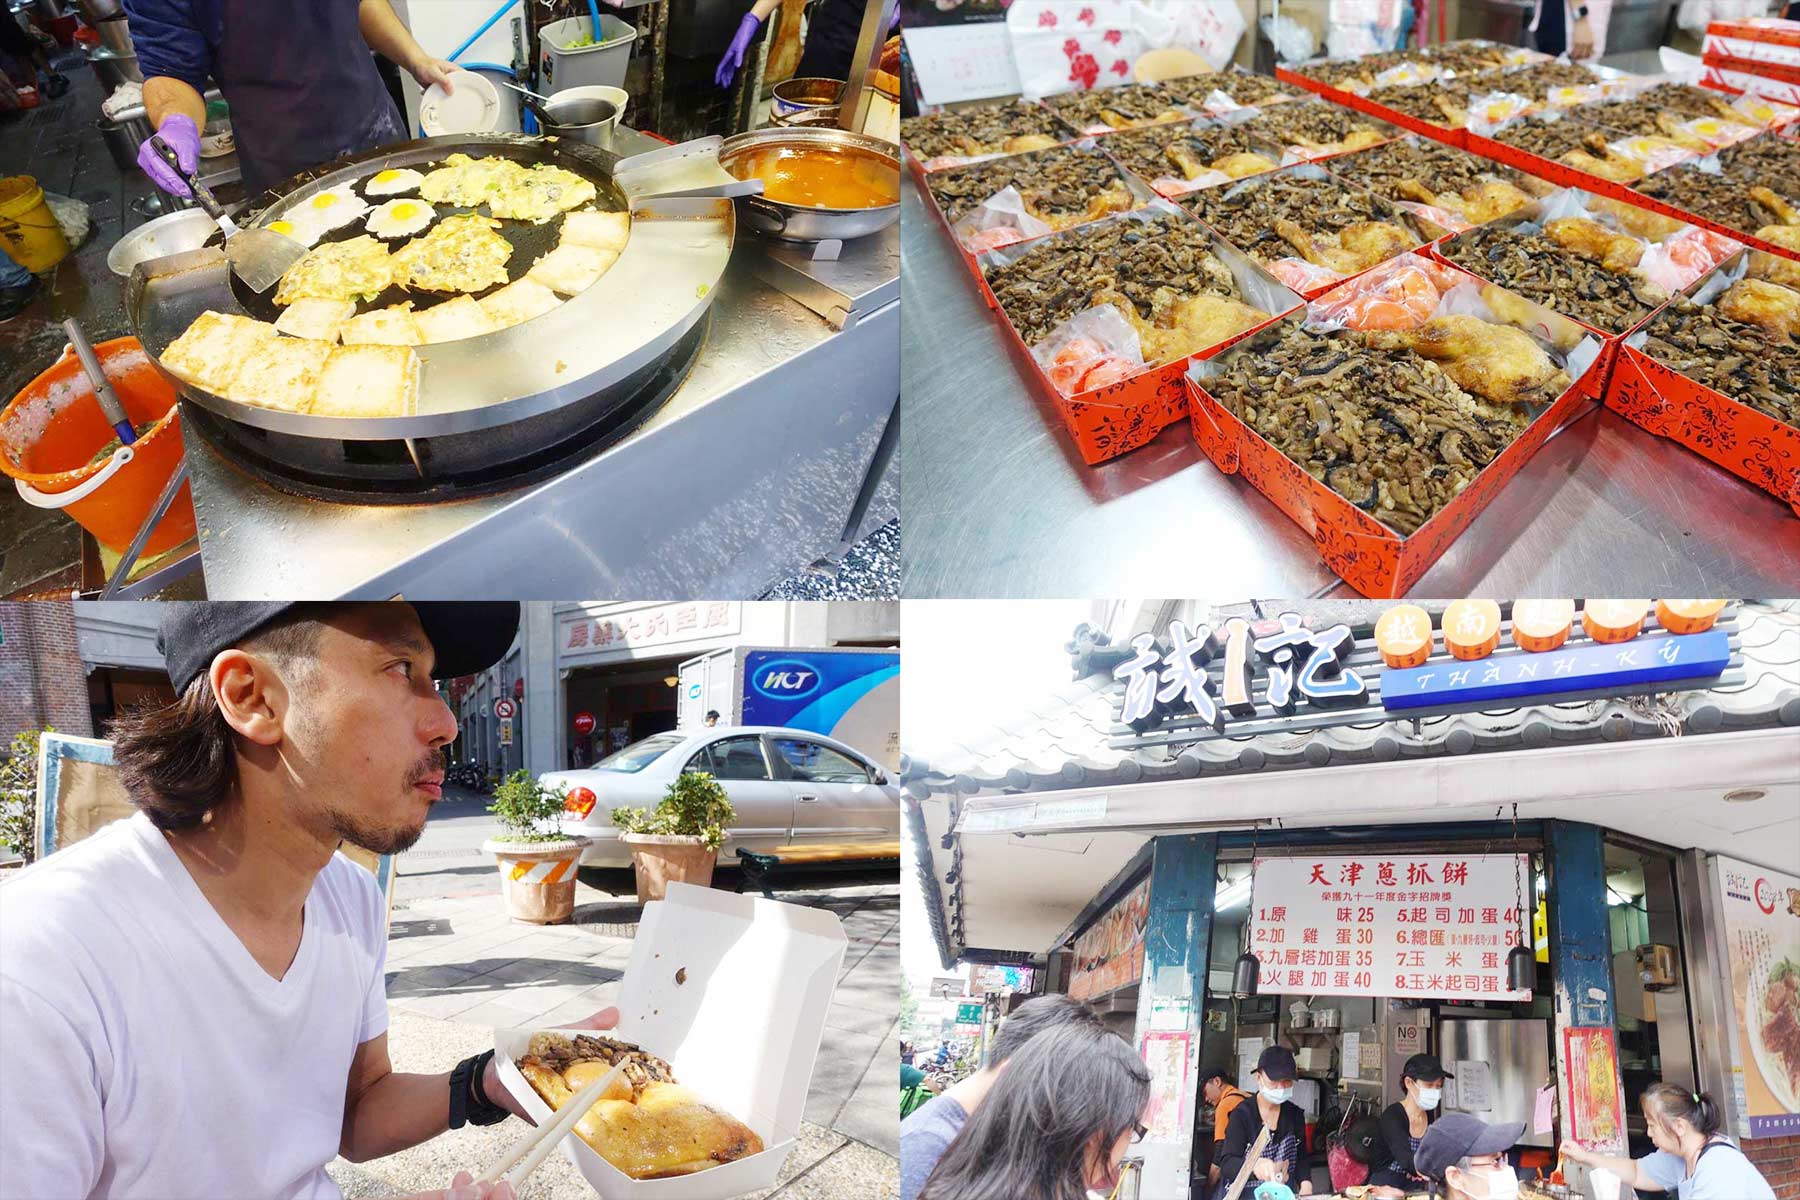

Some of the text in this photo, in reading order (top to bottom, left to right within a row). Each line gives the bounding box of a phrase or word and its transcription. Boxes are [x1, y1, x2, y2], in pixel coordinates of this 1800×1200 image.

[1358, 907, 1374, 922] 25
[1356, 928, 1373, 944] 30
[1355, 950, 1373, 966] 35
[1353, 971, 1372, 988] 40
